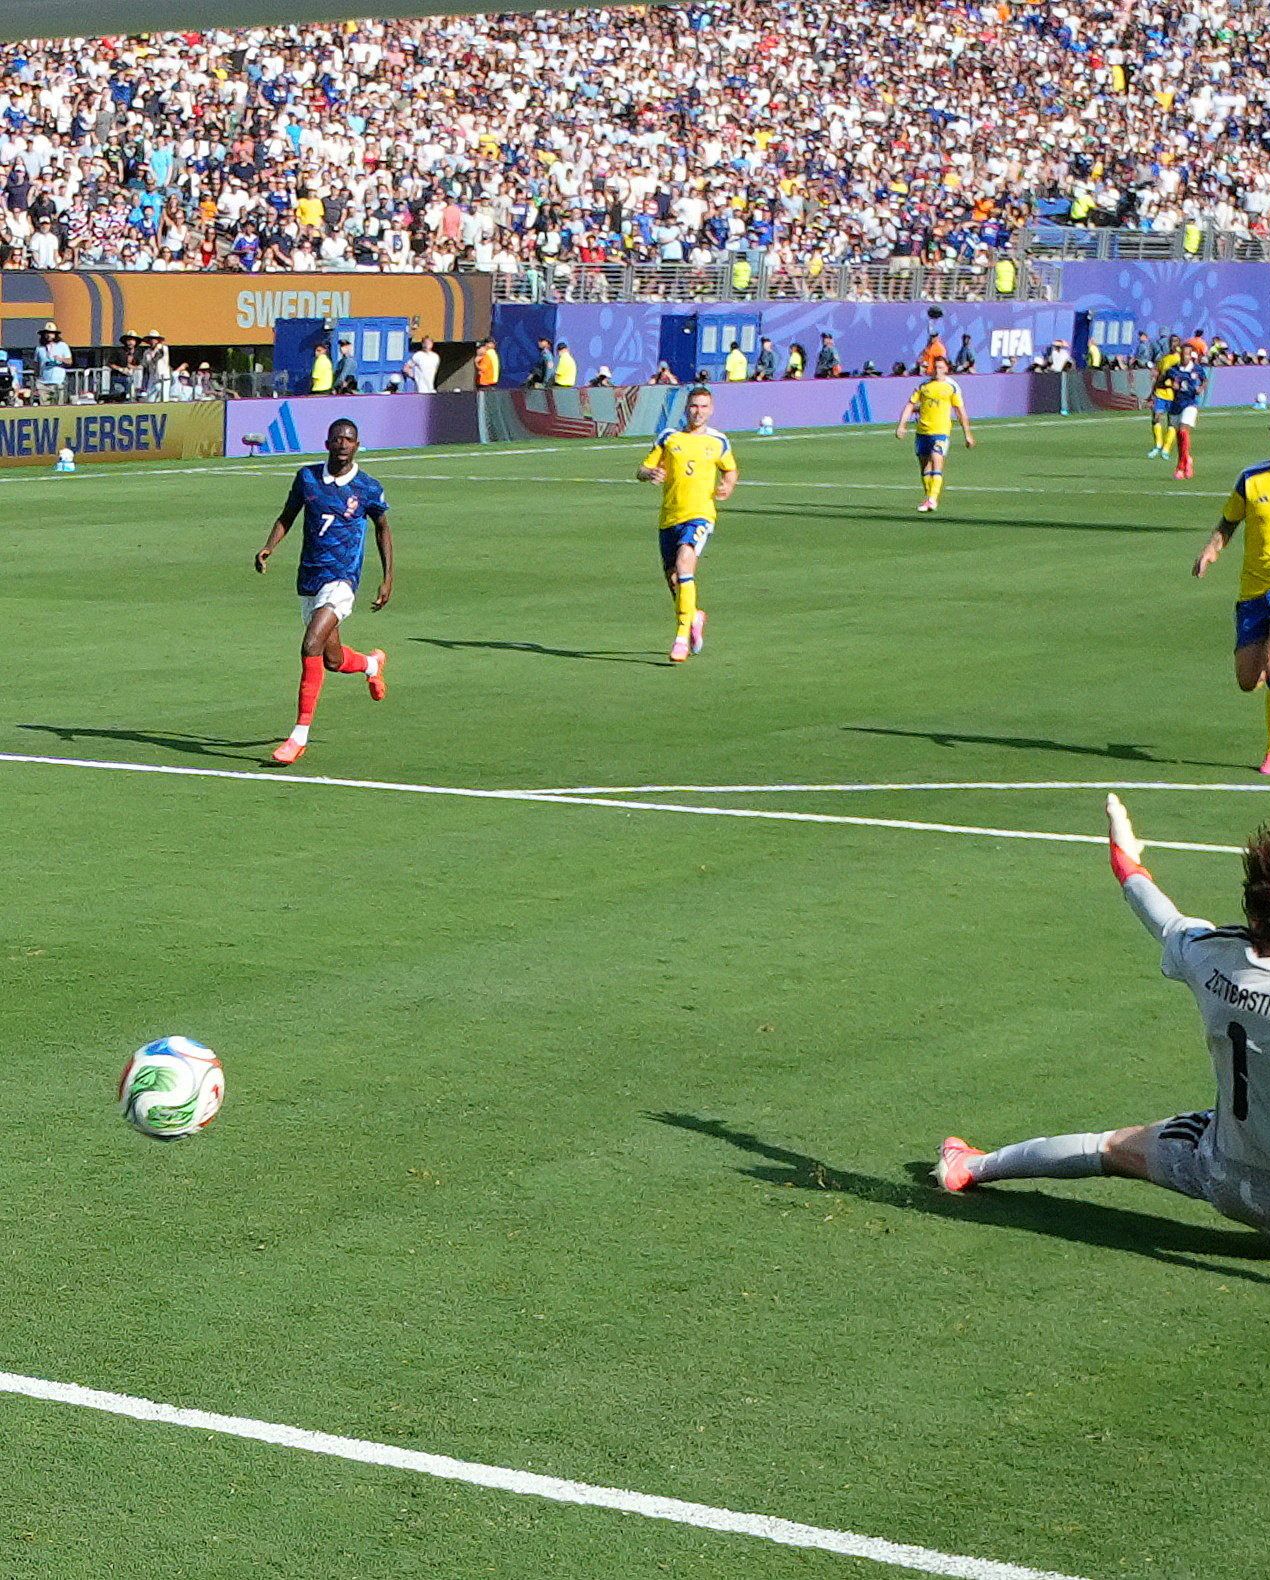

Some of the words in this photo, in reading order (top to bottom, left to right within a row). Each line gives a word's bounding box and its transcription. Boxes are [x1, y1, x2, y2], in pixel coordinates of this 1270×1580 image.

[237, 290, 351, 328] SWEDEN
[991, 328, 1033, 357] FIFA
[0, 417, 60, 456] NEW
[65, 413, 168, 454] JERSEY
[318, 513, 336, 537] 7
[1227, 1021, 1249, 1122] 1
